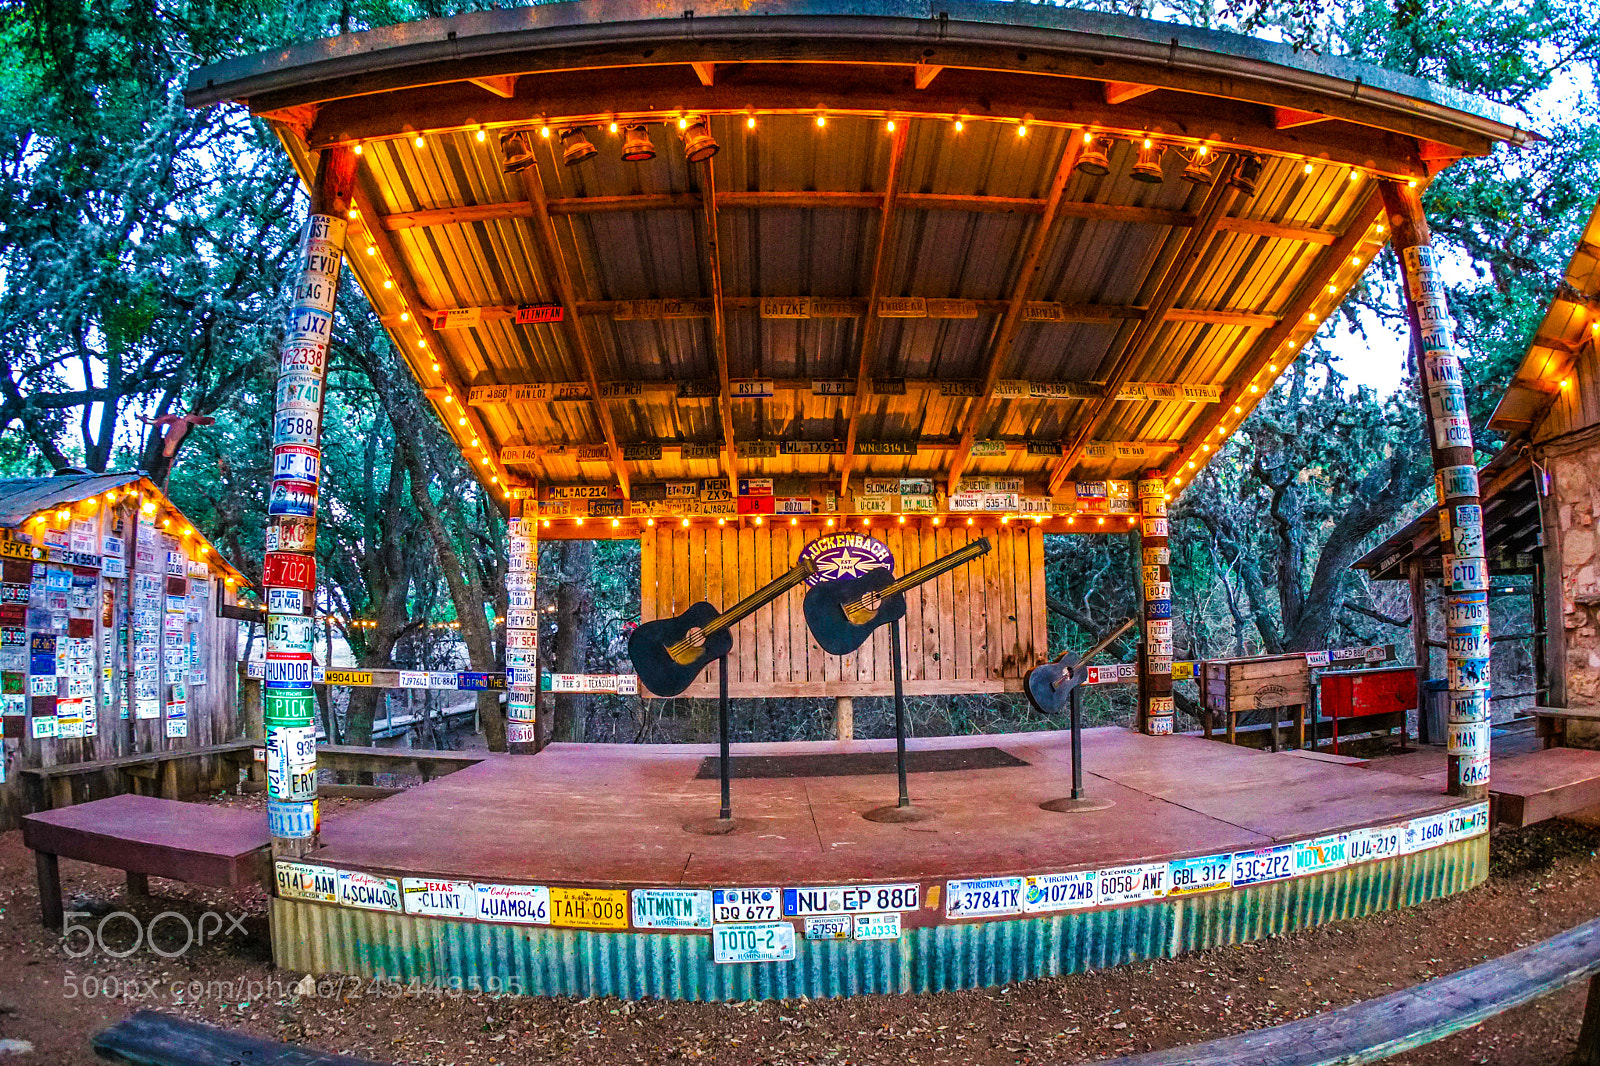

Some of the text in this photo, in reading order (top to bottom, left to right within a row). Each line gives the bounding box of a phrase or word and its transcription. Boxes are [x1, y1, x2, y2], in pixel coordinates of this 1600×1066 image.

[312, 215, 331, 224] EXAS
[765, 303, 806, 315] GATZKE
[739, 383, 765, 394] RST 1
[836, 382, 847, 393] PT
[280, 418, 313, 436] 2588
[787, 440, 844, 452] WL TX 911
[859, 444, 910, 453] WN 314 L
[1118, 447, 1130, 455] THE
[522, 450, 536, 460] 146
[706, 479, 727, 490] WEN
[555, 487, 608, 498] ML AC 214
[707, 490, 721, 501] ZX
[750, 500, 760, 510] 18
[916, 499, 933, 509] MULE
[954, 498, 979, 508] MOUSEY
[3, 542, 23, 556] SFK
[62, 551, 79, 565] SFK
[1453, 565, 1476, 581] CTD
[521, 636, 536, 647] SEA
[326, 673, 350, 682] M904
[352, 674, 371, 684] LUT
[490, 679, 503, 687] THE
[276, 699, 306, 717] PICK
[292, 773, 314, 794] ERY
[1421, 822, 1444, 841] 1606
[1351, 835, 1397, 858] UJ4 219
[1324, 843, 1346, 863] 28K
[276, 864, 314, 874] GEORGIA
[1100, 868, 1143, 877] GEORGIA
[1236, 859, 1260, 879] 53C
[1266, 855, 1289, 875] ZP2
[1043, 875, 1079, 883] VIRGINIA
[1173, 867, 1198, 885] GBL
[1202, 863, 1226, 882] 312
[424, 881, 453, 892] TEXAS
[967, 880, 1004, 889] VIRGINIA
[1101, 876, 1132, 895] 6058
[1142, 871, 1165, 890] AWF
[343, 884, 398, 908] 4SCW406
[490, 886, 532, 899] California
[741, 891, 761, 905] HK
[422, 893, 461, 910] CLINT
[798, 891, 828, 912] NU
[843, 889, 872, 911] EP
[877, 887, 918, 909] 880
[964, 890, 1019, 911] 3784TK
[481, 898, 546, 919] 4UAM846
[554, 900, 625, 919] TAH 008
[637, 897, 692, 917] NTMNTM
[720, 906, 775, 920] DQ 677
[813, 923, 844, 935] 57597
[719, 930, 776, 951] TOTO-2
